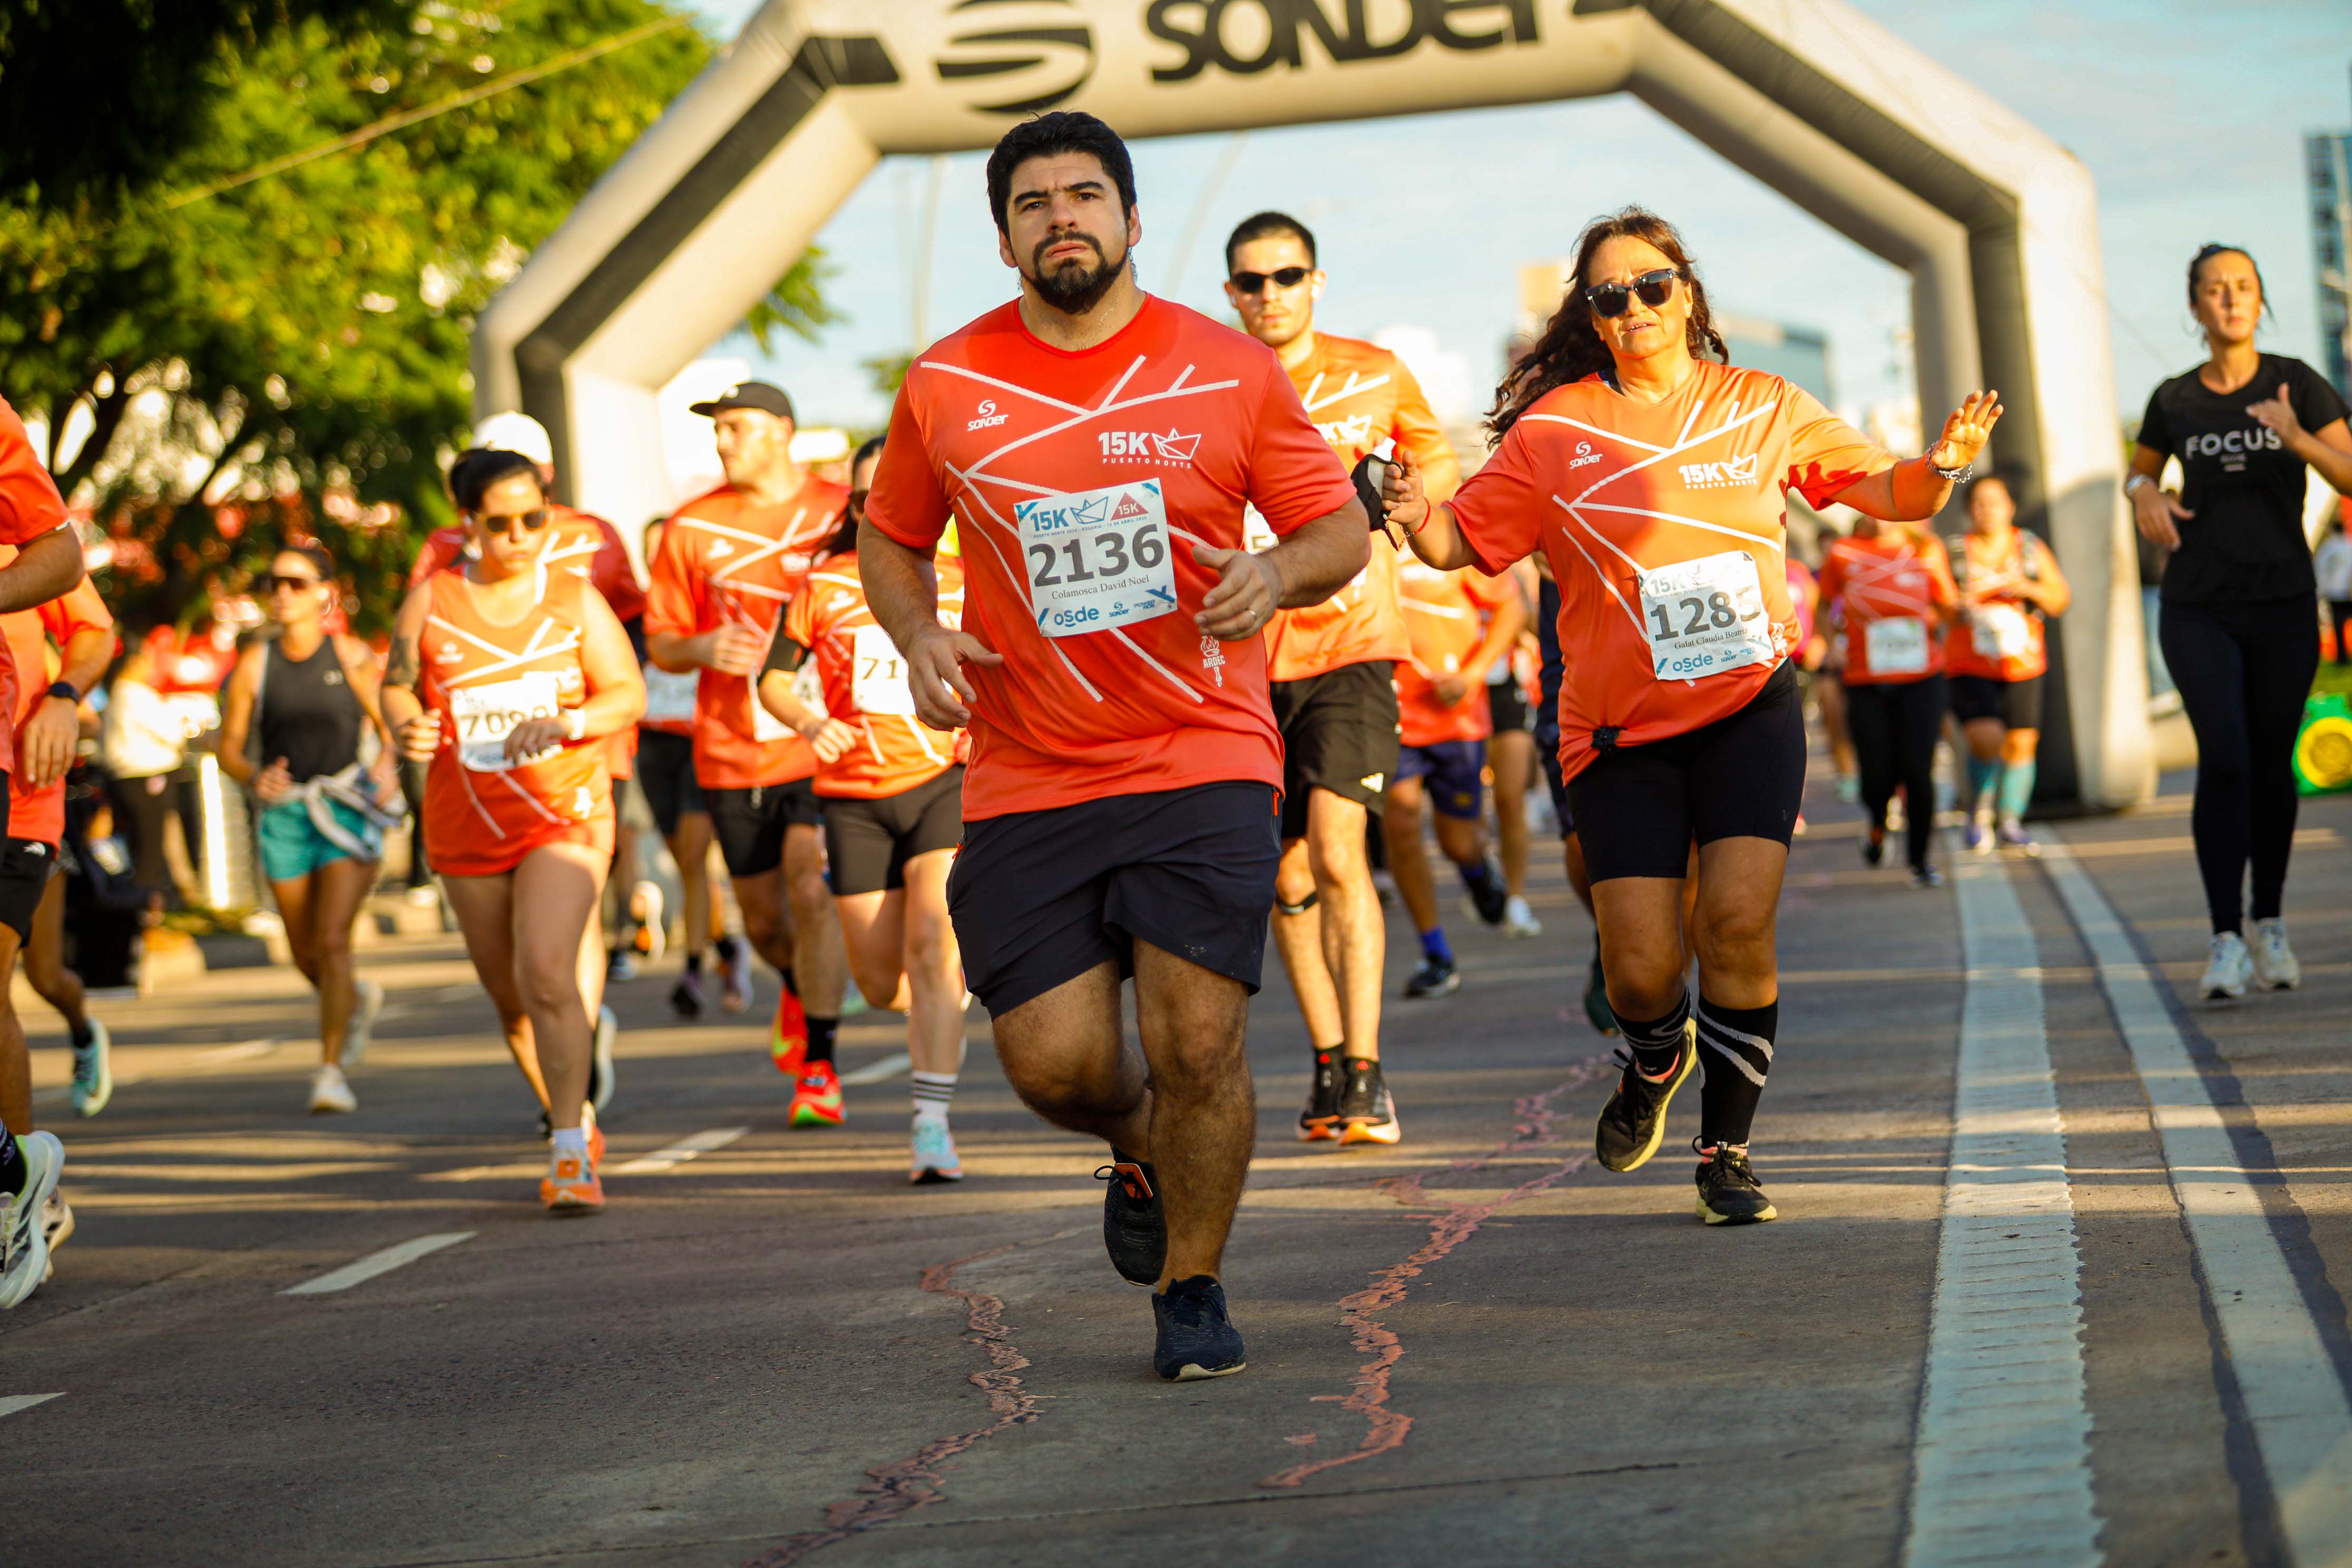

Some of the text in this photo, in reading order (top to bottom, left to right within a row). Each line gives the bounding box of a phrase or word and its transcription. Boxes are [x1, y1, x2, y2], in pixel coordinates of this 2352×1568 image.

[1099, 432, 1150, 455] 15K
[2185, 427, 2282, 460] FOCUS
[1155, 459, 1191, 468] NORTE
[1678, 462, 1724, 484] 15K
[1118, 502, 1140, 515] 15K
[1030, 508, 1069, 532] 15K
[1029, 524, 1164, 587] 2136
[1052, 574, 1149, 600] Colamosca David Noel
[1054, 605, 1100, 627] osde
[1651, 585, 1761, 641] 1285
[1674, 628, 1748, 649] Galat Claudia Beatriz
[1203, 655, 1226, 669] ARDEC
[1672, 653, 1713, 672] osde
